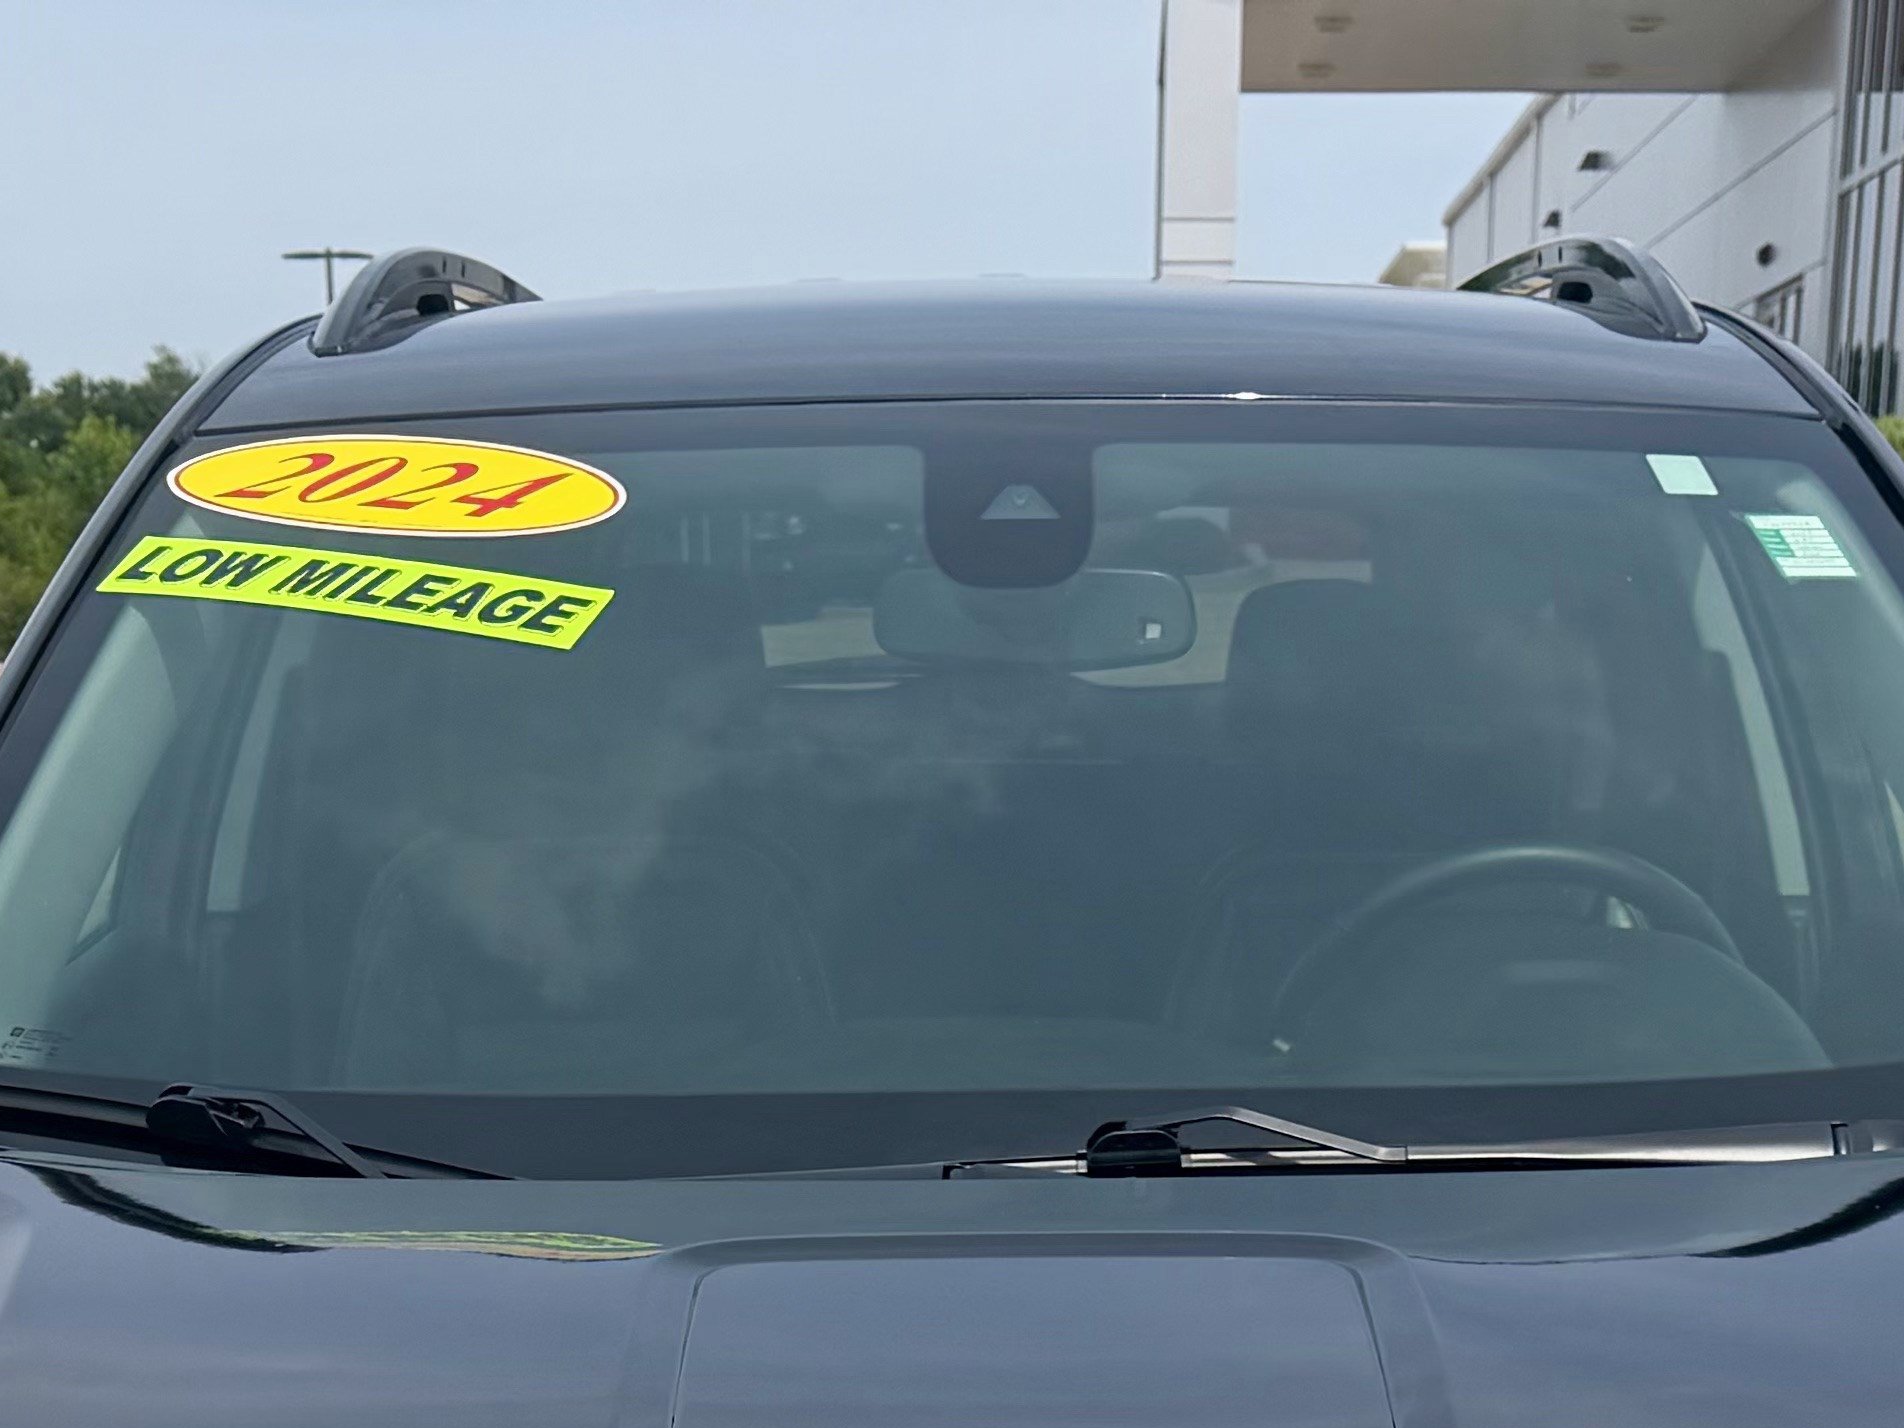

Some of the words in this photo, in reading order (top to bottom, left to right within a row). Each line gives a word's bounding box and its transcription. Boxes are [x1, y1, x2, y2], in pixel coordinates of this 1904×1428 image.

[214, 453, 573, 517] 2024
[116, 545, 292, 590] LOW
[268, 557, 597, 637] MILEAGE
